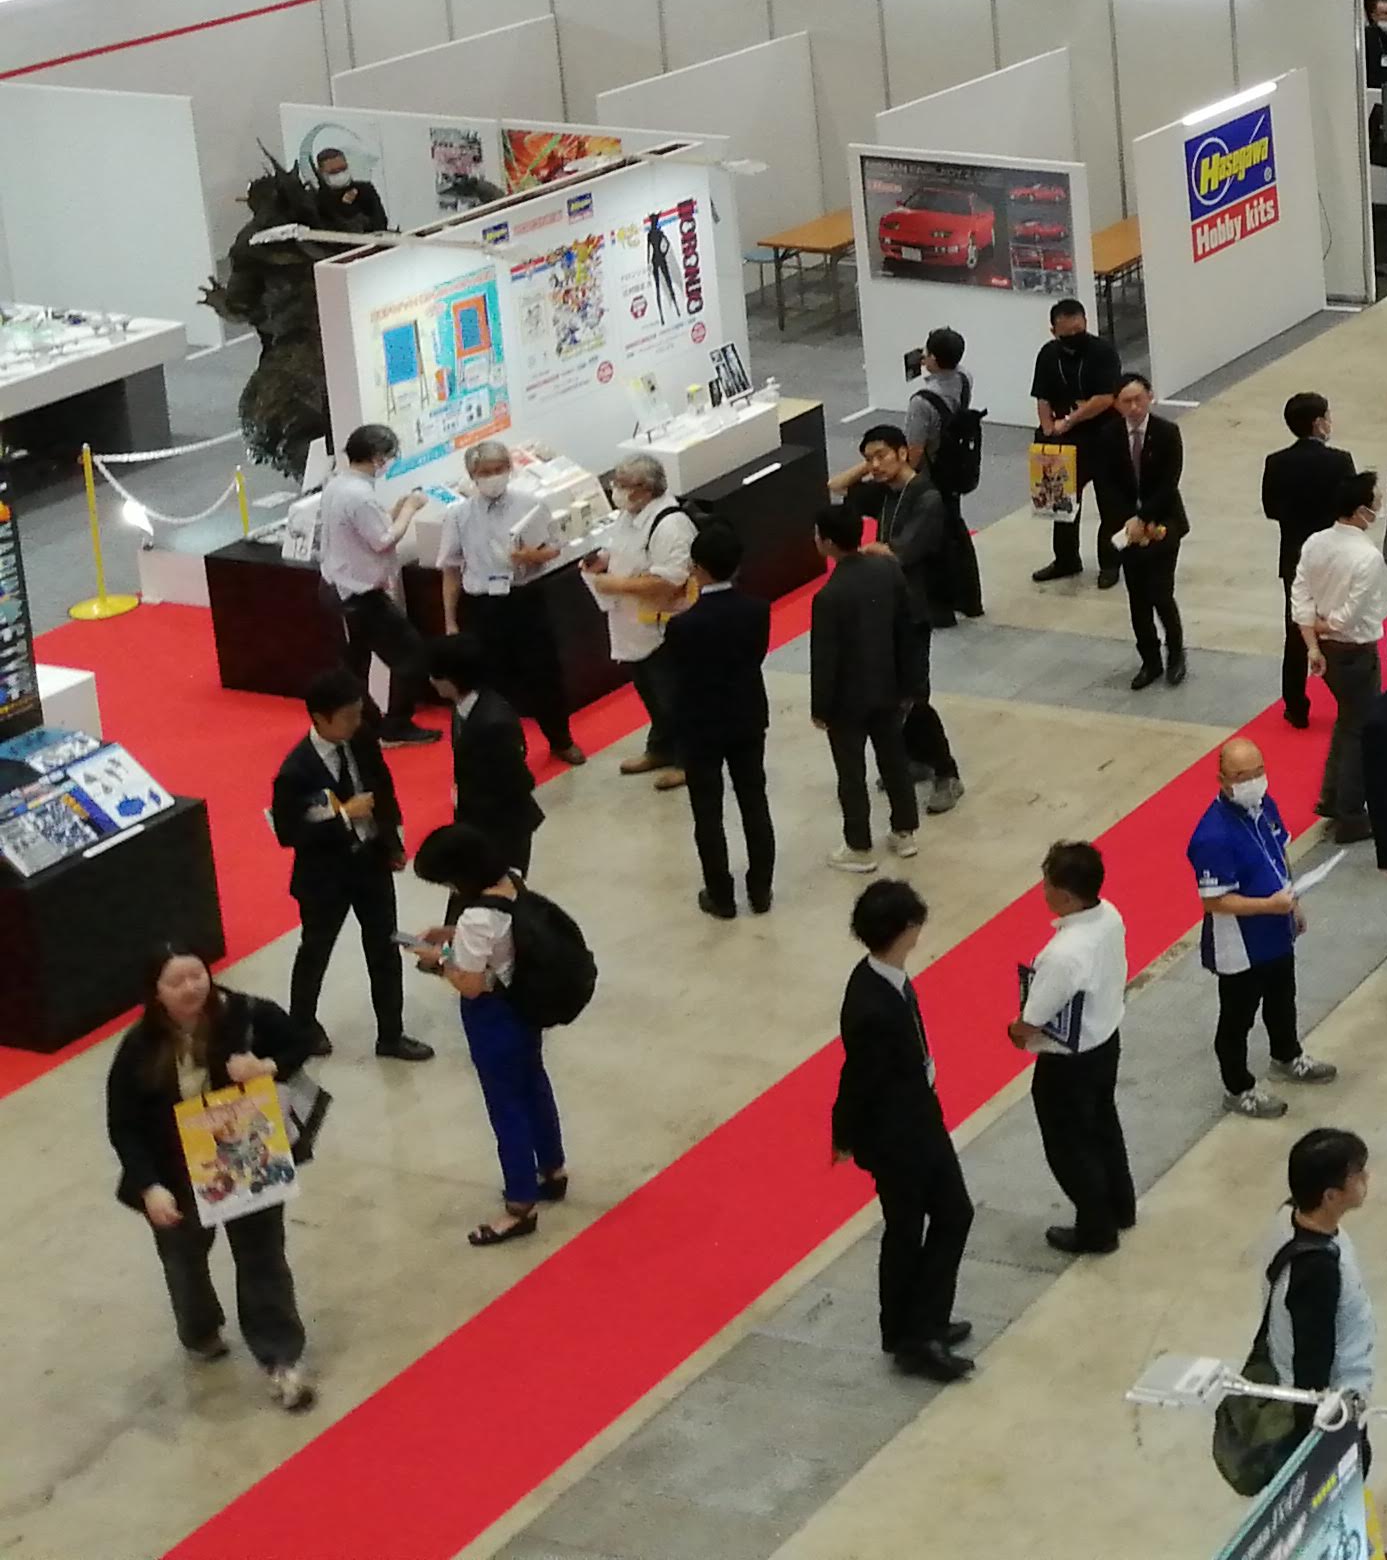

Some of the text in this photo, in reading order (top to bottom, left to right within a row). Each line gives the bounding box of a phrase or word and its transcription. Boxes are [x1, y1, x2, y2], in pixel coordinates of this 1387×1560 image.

[1200, 137, 1269, 196] Hasegawa
[1196, 197, 1275, 256] Hobby kits
